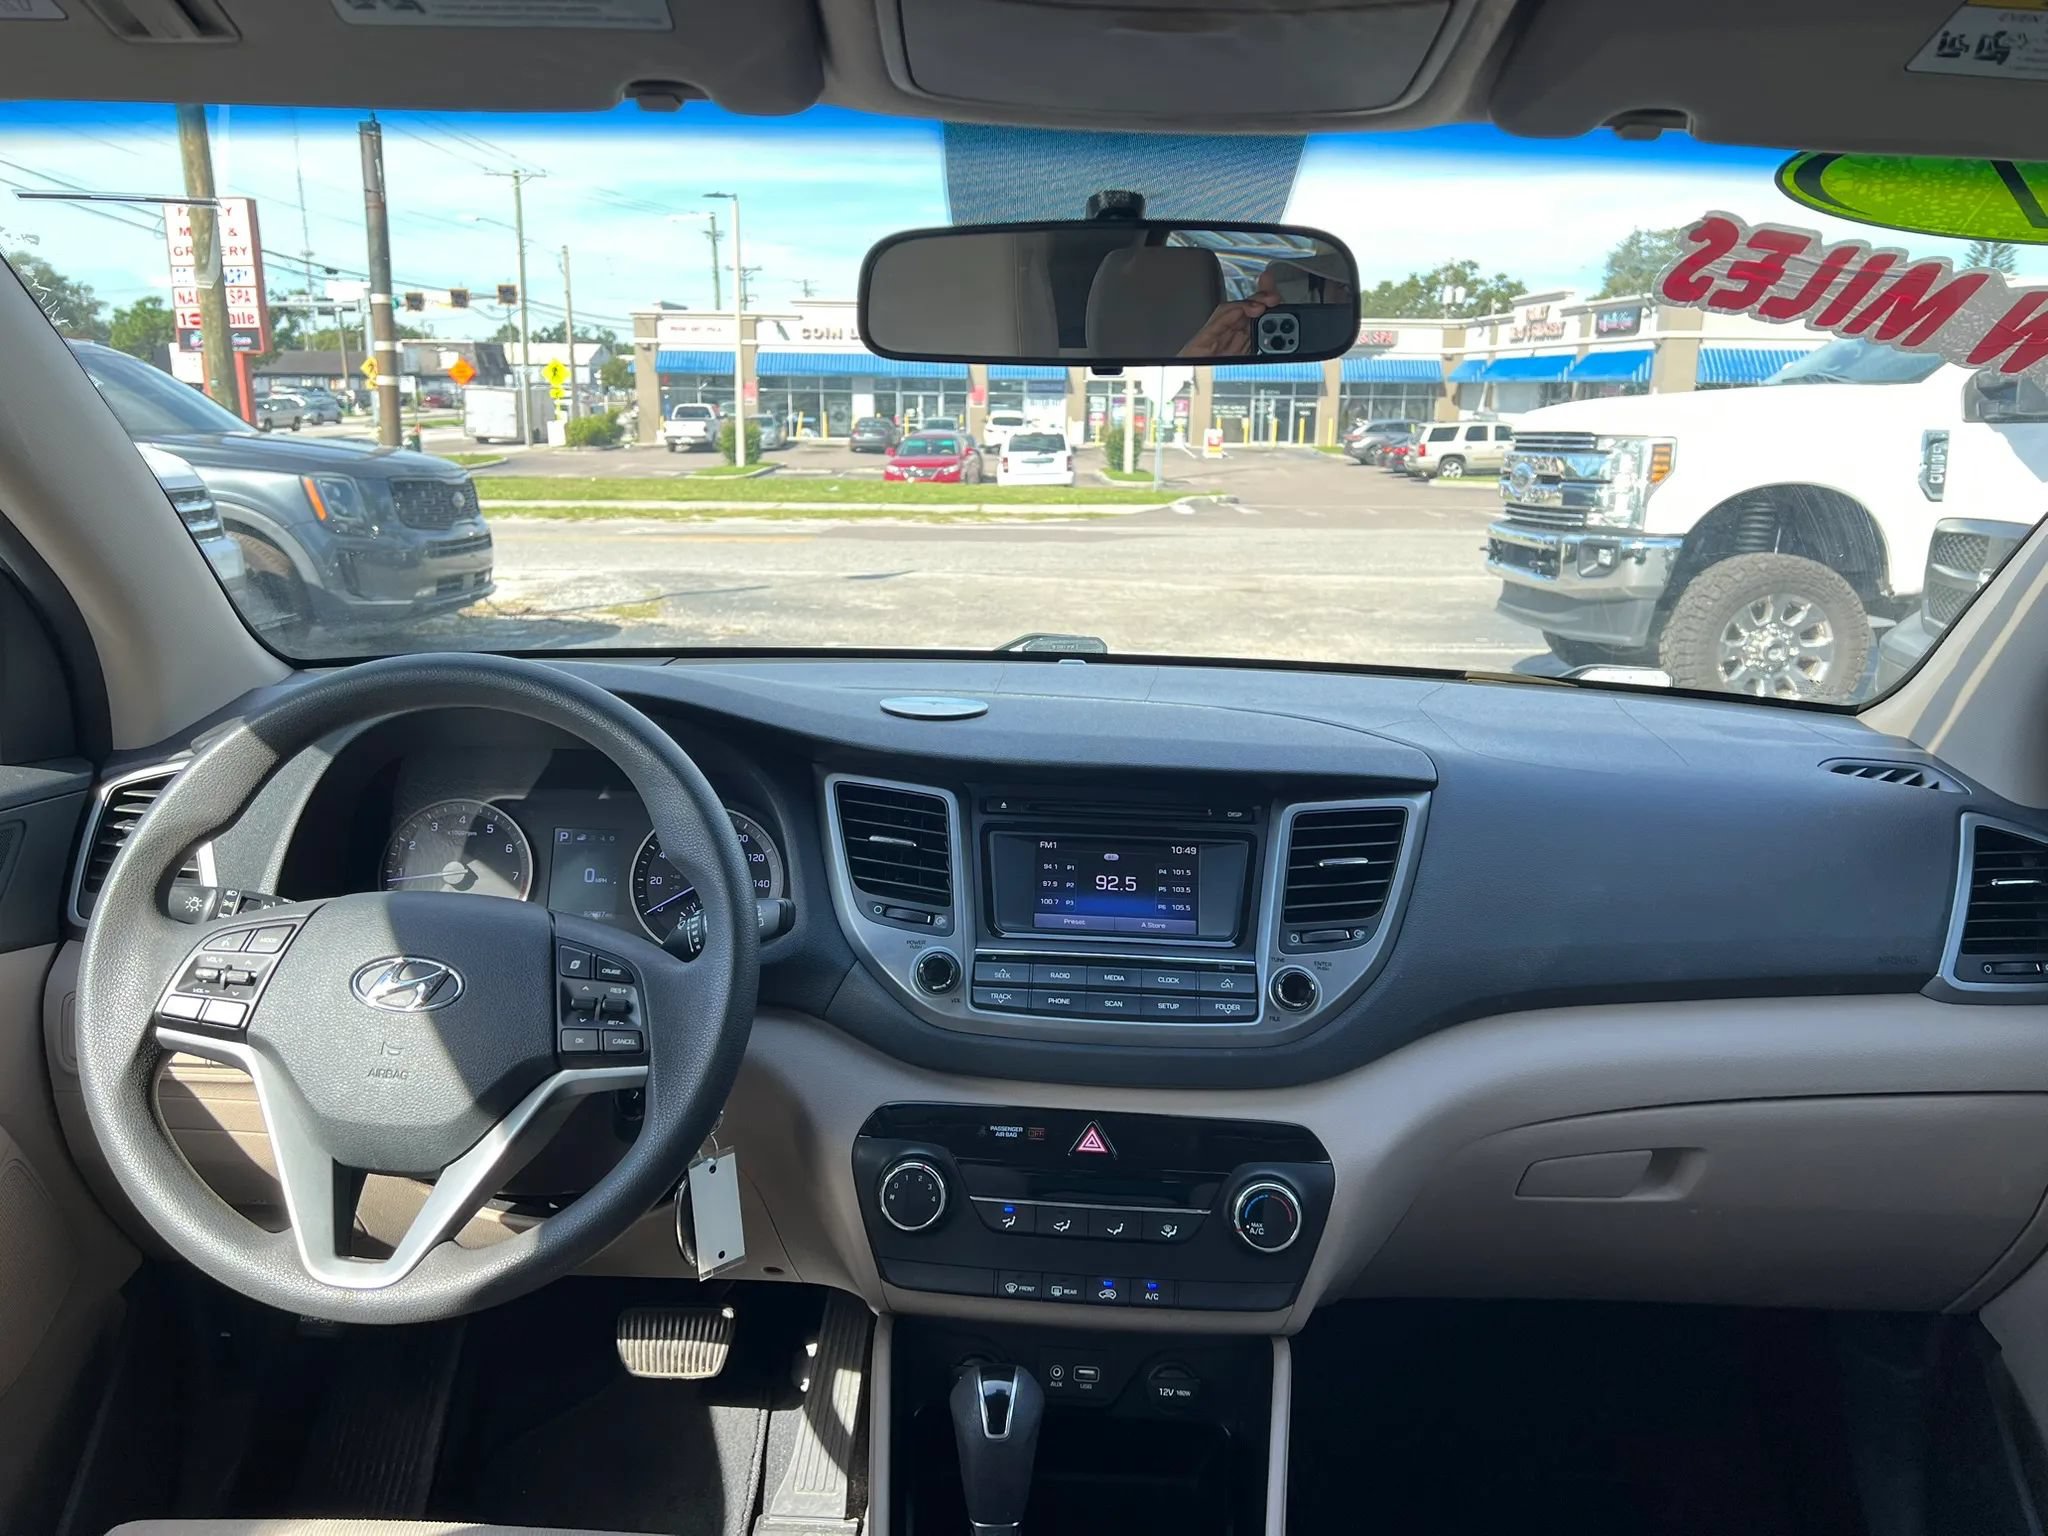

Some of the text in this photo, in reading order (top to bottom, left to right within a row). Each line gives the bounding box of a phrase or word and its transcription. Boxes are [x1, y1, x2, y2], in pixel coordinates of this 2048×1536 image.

[173, 246, 248, 257] GRERY
[802, 327, 843, 340] COIN
[459, 815, 466, 824] 4
[431, 822, 438, 832] 3
[486, 824, 494, 833] 5
[559, 831, 569, 841] P
[408, 840, 416, 850] 2
[505, 843, 513, 853] 6
[1039, 841, 1057, 849] FM1
[1171, 846, 1197, 855] 10:49
[748, 853, 765, 862] 120
[512, 871, 519, 881] 7
[584, 867, 595, 883] 0
[650, 876, 663, 885] 20
[753, 879, 770, 888] 140
[1095, 875, 1137, 892] 92.5
[1104, 974, 1125, 982] MEDIA
[1157, 976, 1180, 984] CLOCK
[1220, 981, 1235, 989] CAT
[991, 992, 1012, 1000] TRACK
[1048, 997, 1071, 1005] PHONE
[1157, 1002, 1180, 1010] SETUP
[1215, 1003, 1241, 1011] FOLDER
[367, 1067, 409, 1080] AIRBAG
[1249, 1227, 1265, 1235] A/C
[1050, 1380, 1063, 1388] AUX
[1159, 1387, 1175, 1397] 12V
